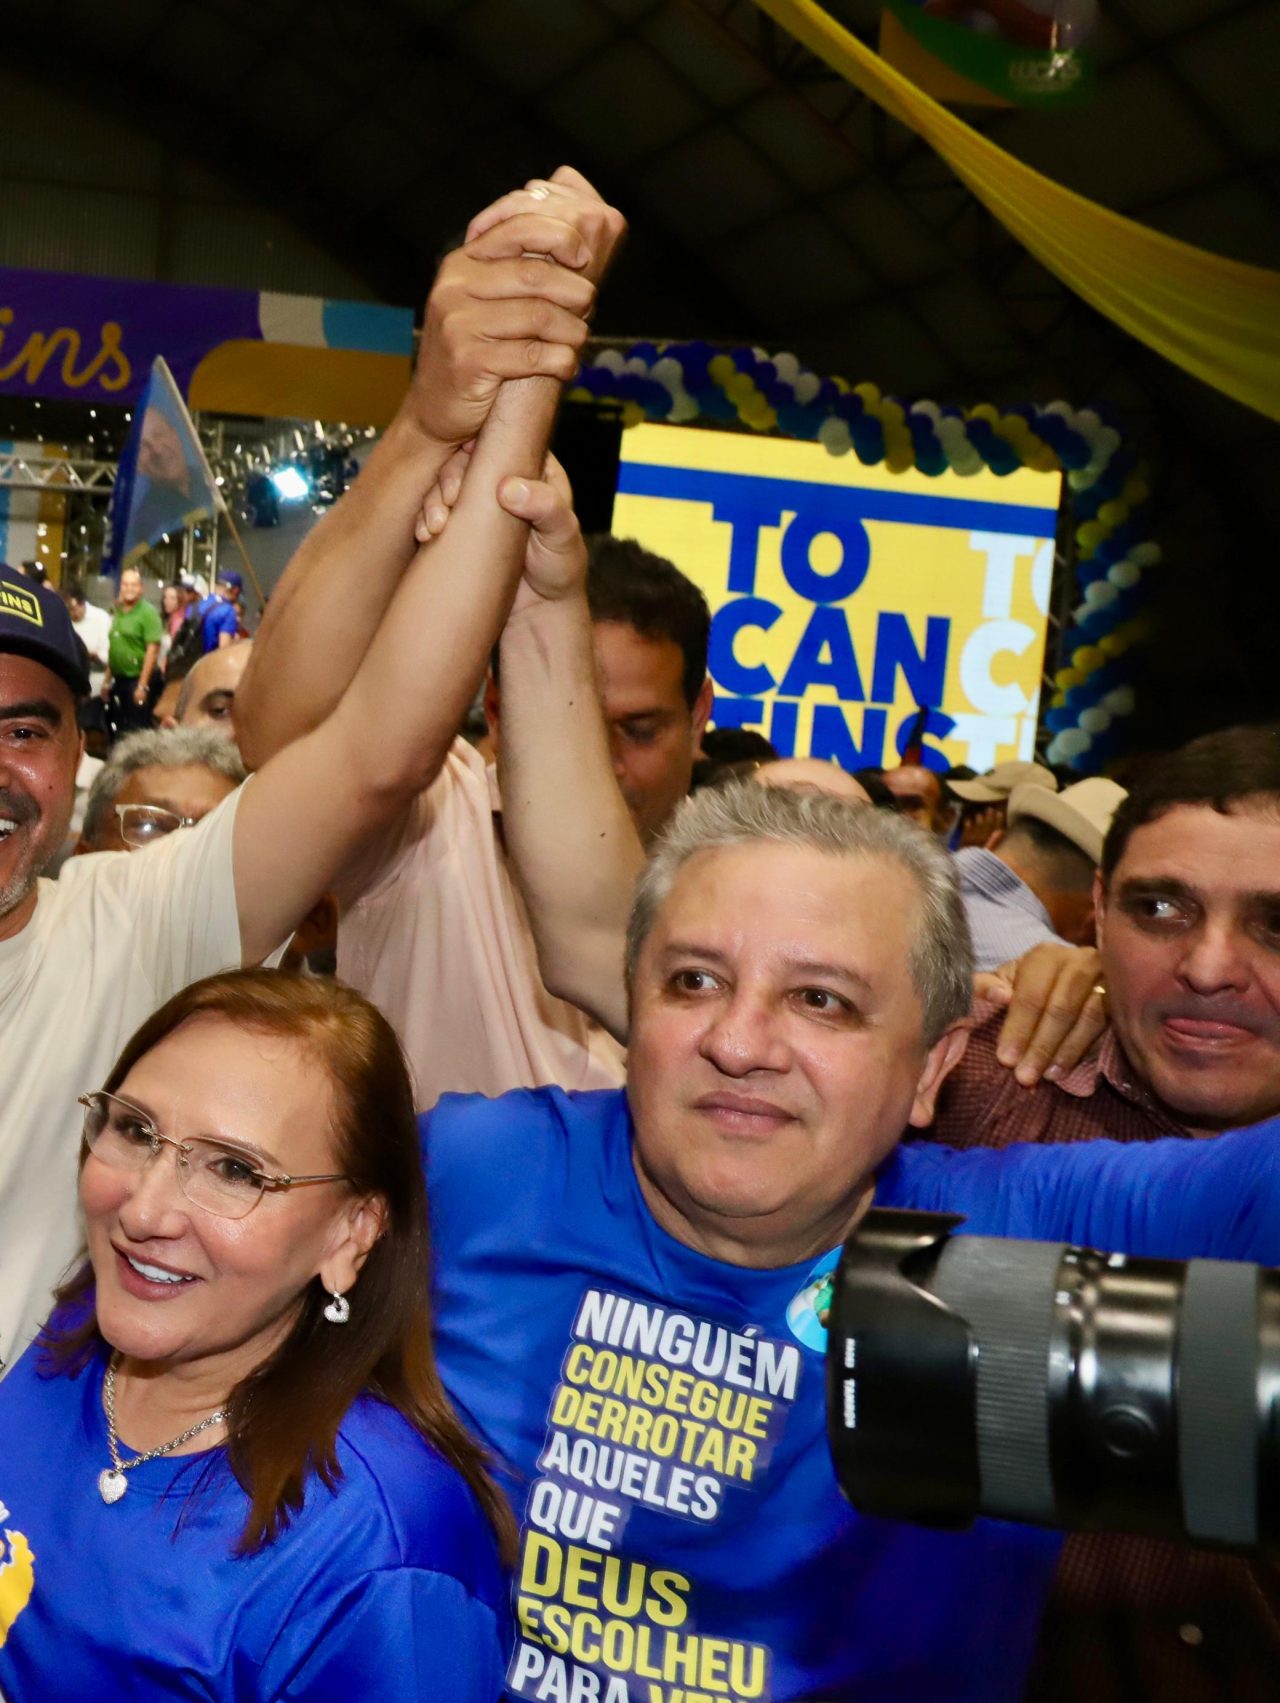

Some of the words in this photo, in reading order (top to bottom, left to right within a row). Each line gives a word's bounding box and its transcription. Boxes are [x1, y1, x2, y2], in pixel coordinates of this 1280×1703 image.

[712, 503, 870, 603] TO
[707, 597, 951, 707] CAN
[566, 1342, 773, 1439] CONSEGUE
[574, 1289, 802, 1401] NINGUÉM
[550, 1385, 758, 1482] DERROTAR
[844, 1378, 856, 1428] TAMRON
[529, 1481, 622, 1550] QUE
[542, 1432, 720, 1522] AQUELES
[520, 1533, 692, 1628] DEUS
[511, 1642, 630, 1703] PARA
[517, 1596, 766, 1699] ESCOLHEU
